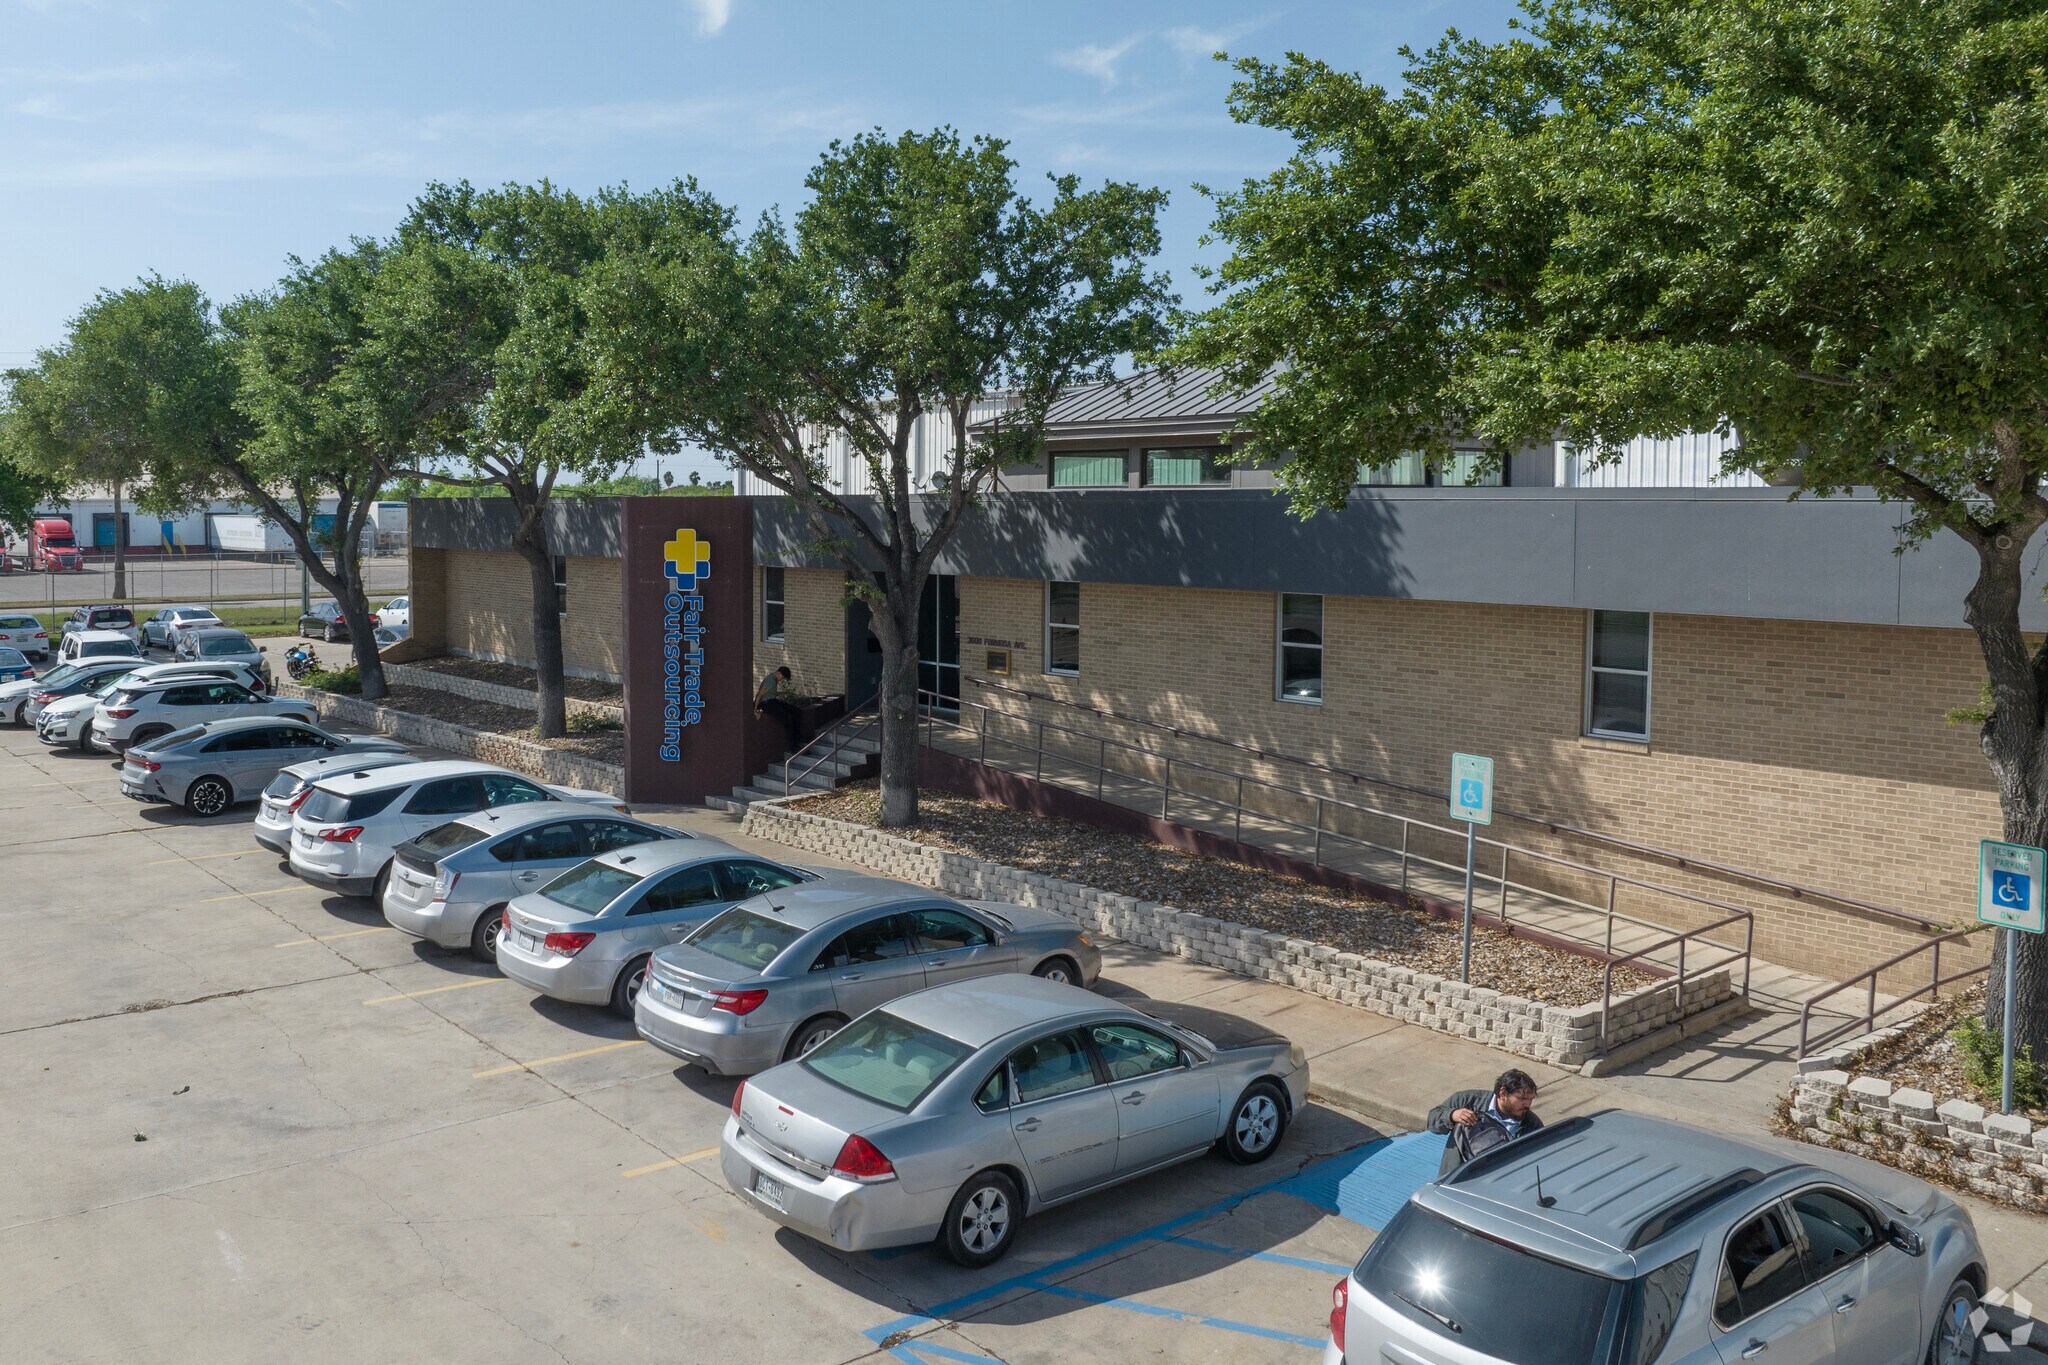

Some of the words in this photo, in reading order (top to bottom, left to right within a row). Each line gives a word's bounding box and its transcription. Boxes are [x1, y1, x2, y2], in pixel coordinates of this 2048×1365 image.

[684, 595, 706, 644] Fair
[660, 592, 688, 762] Outsourcing
[684, 647, 705, 725] Trade
[1992, 847, 2032, 861] RESERVED
[1995, 858, 2029, 871] PARKING
